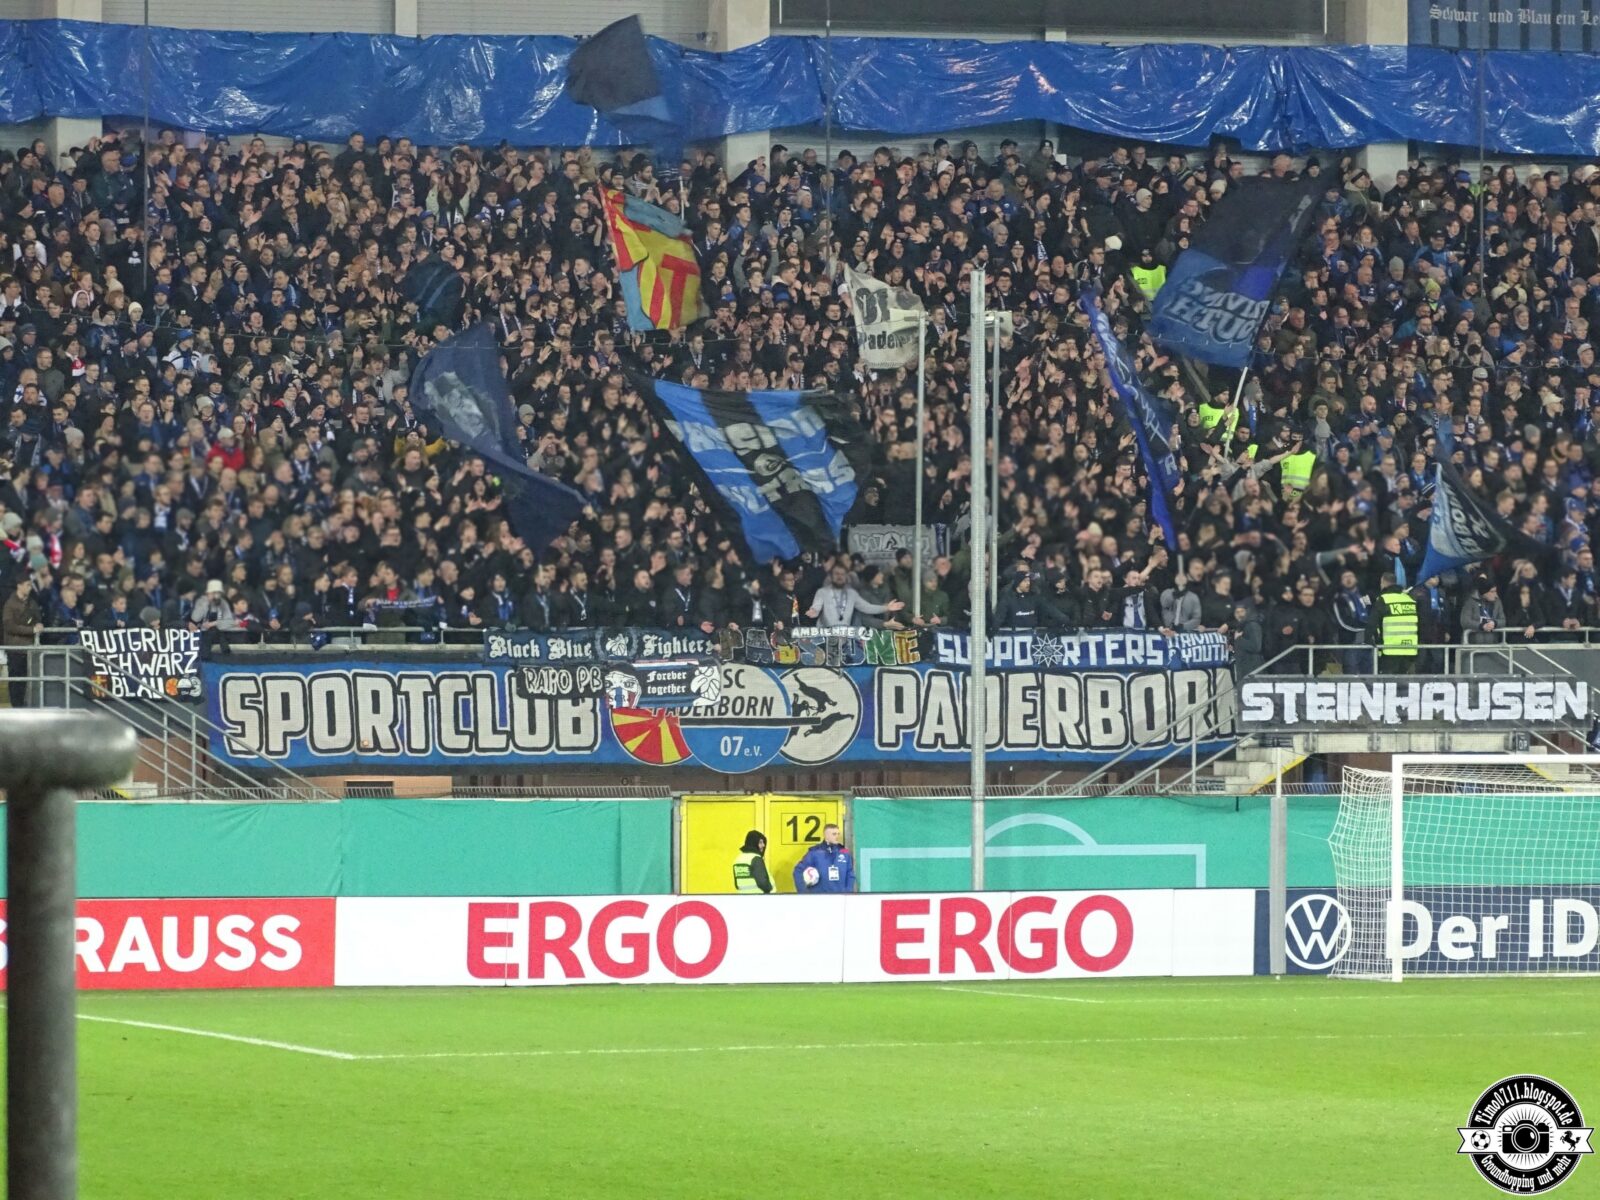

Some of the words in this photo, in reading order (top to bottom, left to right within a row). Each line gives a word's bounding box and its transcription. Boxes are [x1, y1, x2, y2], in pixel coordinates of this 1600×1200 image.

[1489, 9, 1513, 23] und
[1517, 8, 1551, 24] Blau
[1556, 12, 1575, 25] ein
[80, 628, 200, 653] BLUTGRUPPE
[791, 626, 856, 639] AMBIENTE
[488, 635, 540, 659] Black
[547, 638, 592, 660] Blue
[1181, 644, 1229, 665] YOUTH
[92, 651, 198, 676] SCHWARZ
[647, 670, 687, 682] Forever
[111, 676, 165, 699] BLAU
[576, 666, 603, 693] PB
[647, 683, 687, 696] together
[723, 668, 746, 689] SC
[221, 669, 600, 758] SPORTCLUB
[1241, 681, 1588, 724] STEINHAUSEN
[720, 735, 744, 757] 07
[786, 815, 822, 843] 12
[466, 900, 729, 978] ERGO
[879, 895, 1134, 974] ERGO
[1385, 899, 1509, 960] Der
